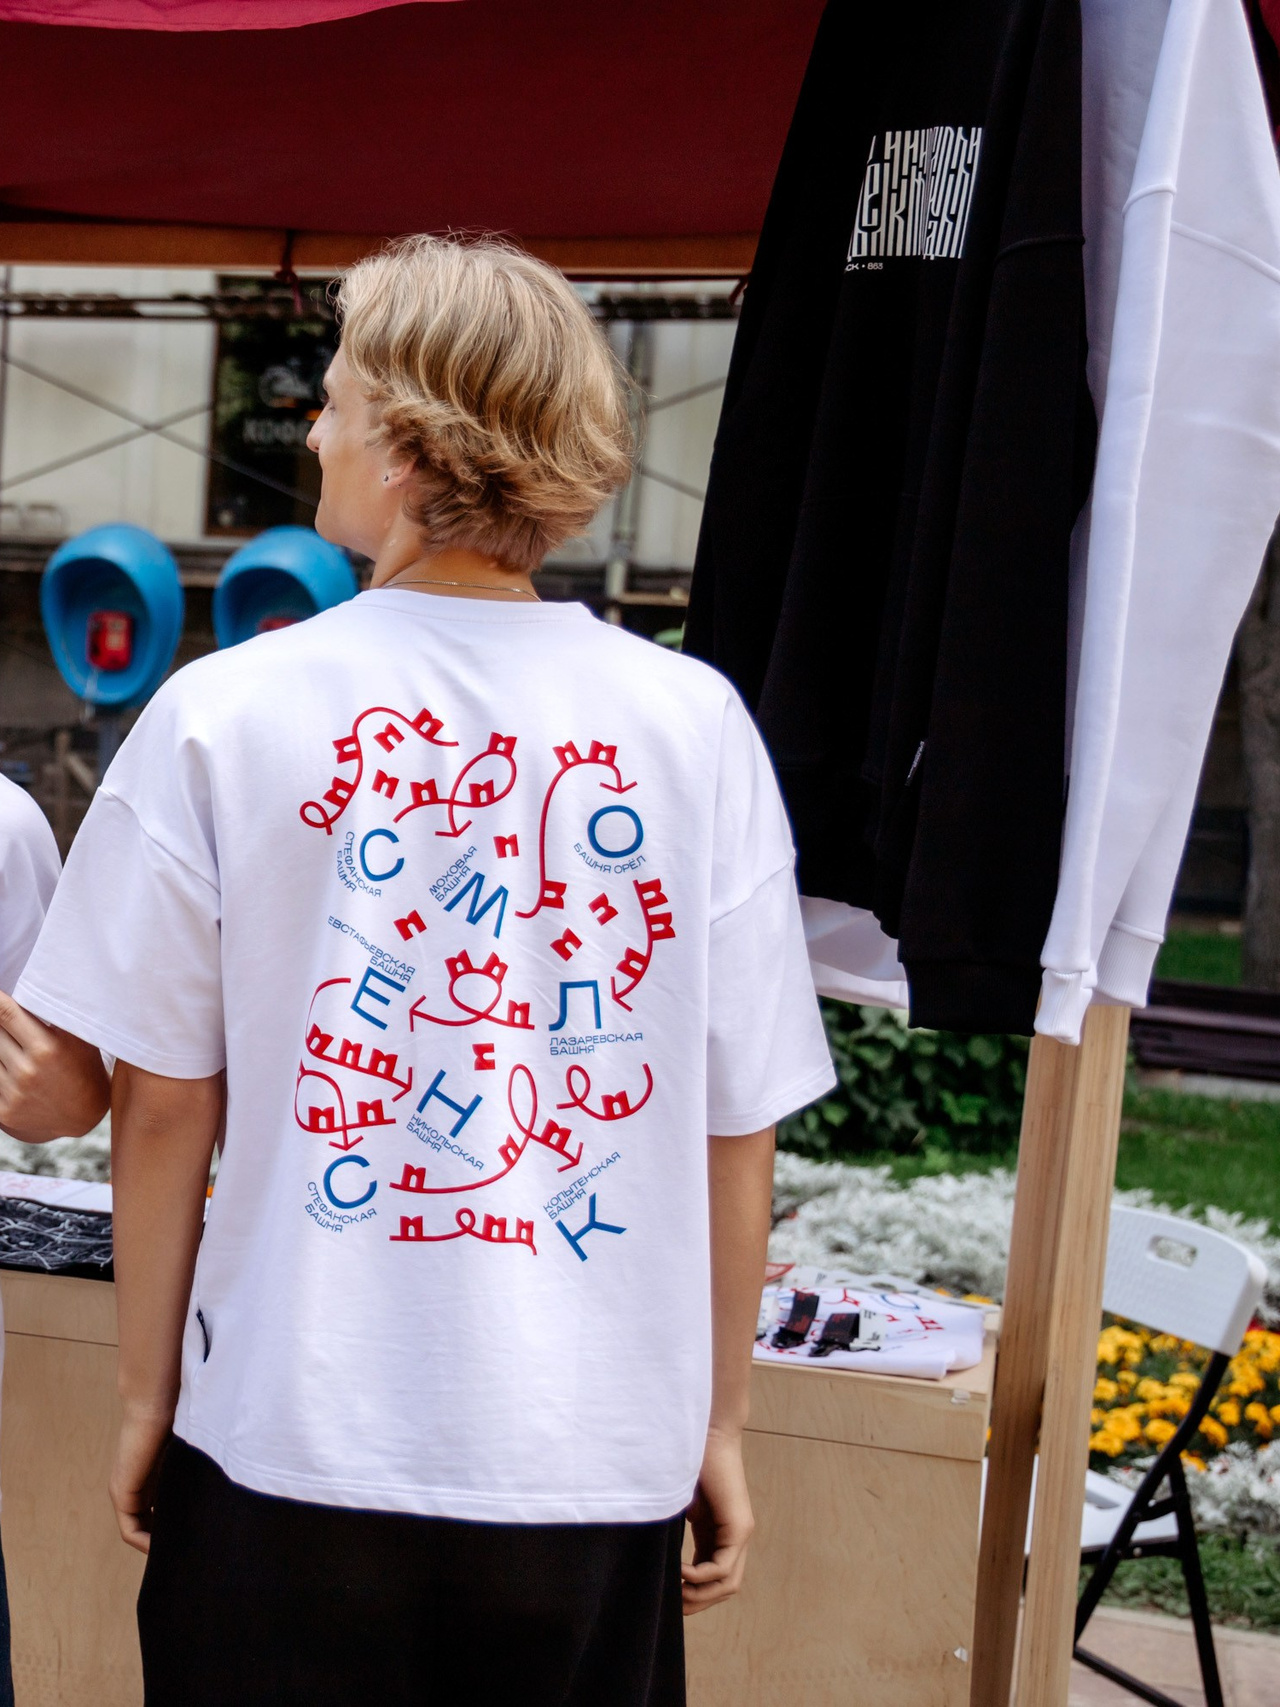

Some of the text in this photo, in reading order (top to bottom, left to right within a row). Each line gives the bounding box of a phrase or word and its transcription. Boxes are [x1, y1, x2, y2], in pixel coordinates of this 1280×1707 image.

[359, 828, 405, 882] С
[587, 804, 644, 859] О
[336, 850, 357, 893] БАШНЯ
[343, 831, 382, 897] СТЕФАНСКАЯ
[428, 845, 478, 896] МОХОВАЯ
[434, 865, 471, 902] БАШНЯ
[573, 842, 647, 874] БАШНЯ ОРЁЛ
[443, 871, 509, 940] М
[328, 915, 416, 976] ЕВСТАФЬЕВСКАЯ
[369, 955, 412, 984] БАШНЯ
[350, 966, 407, 1031] Е
[548, 980, 602, 1032] Л
[549, 1032, 644, 1047] ЛАЗАРЕВСКАЯ
[549, 1044, 596, 1056] БАШНЯ
[416, 1069, 483, 1139] Н
[406, 1121, 442, 1153] БАШНЯ
[410, 1113, 485, 1171] НИКОЛЬСКАЯ
[307, 1181, 378, 1224] СТЕФАНСКАЯ
[323, 1154, 378, 1210] С
[543, 1151, 622, 1213] КОПЫТЕНСКАЯ
[547, 1188, 587, 1220] БАШНЯ
[304, 1203, 343, 1233] БАШНЯ
[555, 1192, 628, 1262] К
